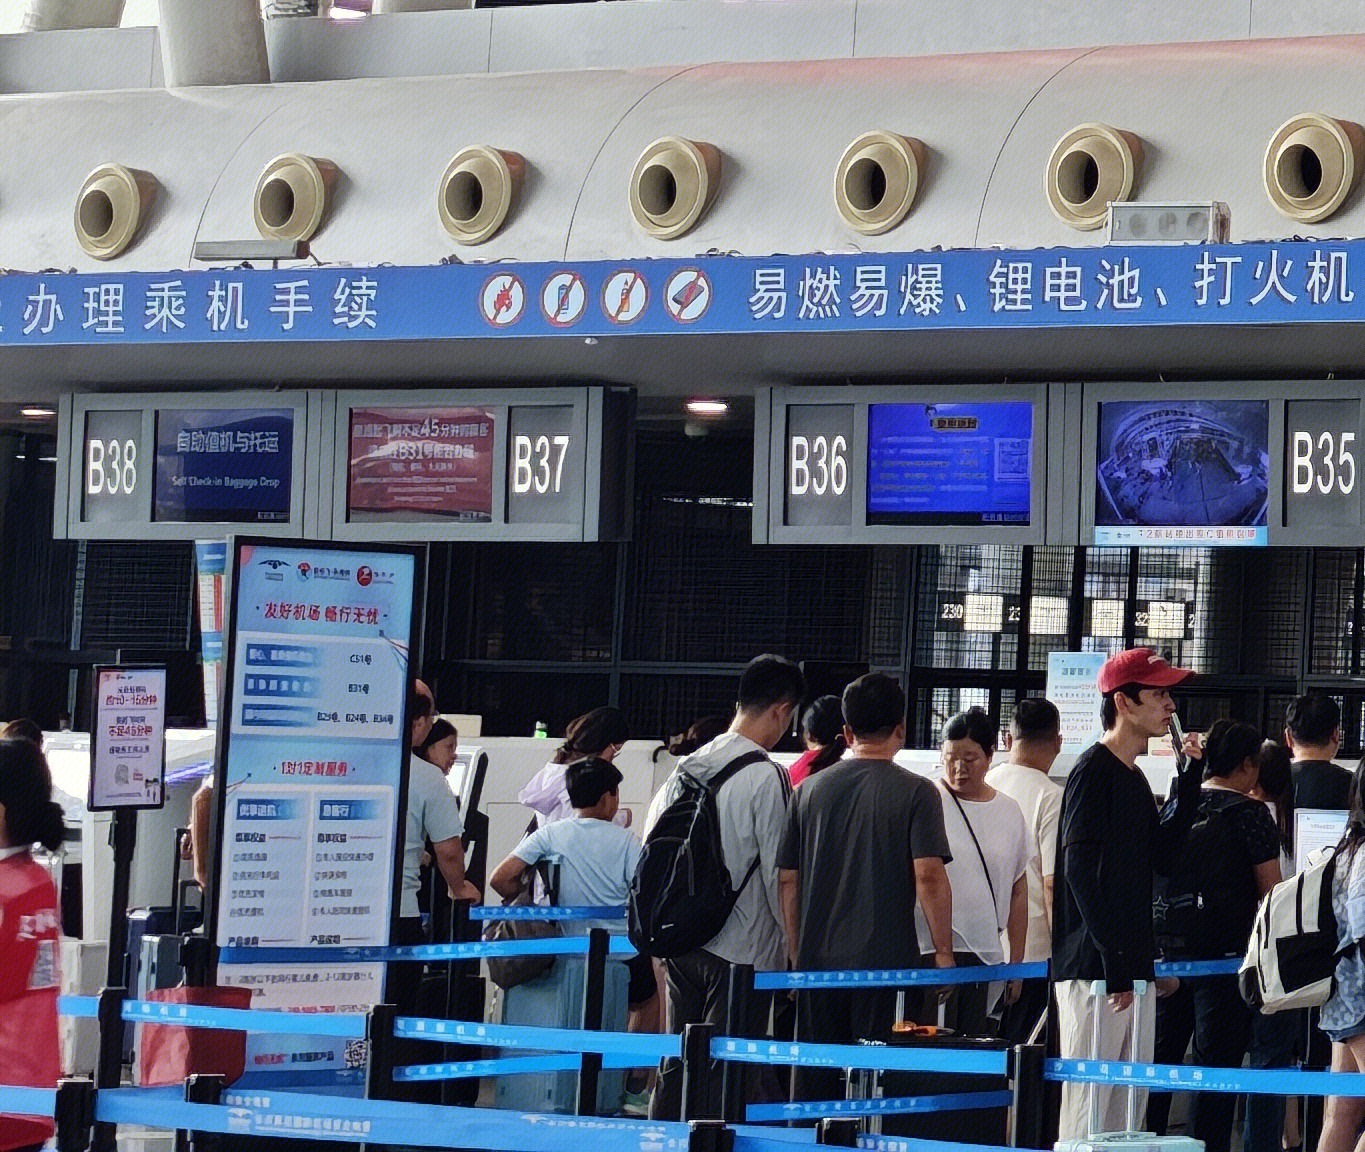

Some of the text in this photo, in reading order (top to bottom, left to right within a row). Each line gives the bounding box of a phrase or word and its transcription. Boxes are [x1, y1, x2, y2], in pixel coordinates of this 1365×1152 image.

[87, 439, 137, 495] B38
[512, 435, 570, 493] B37
[791, 435, 848, 495] B36
[1293, 431, 1356, 494] B35
